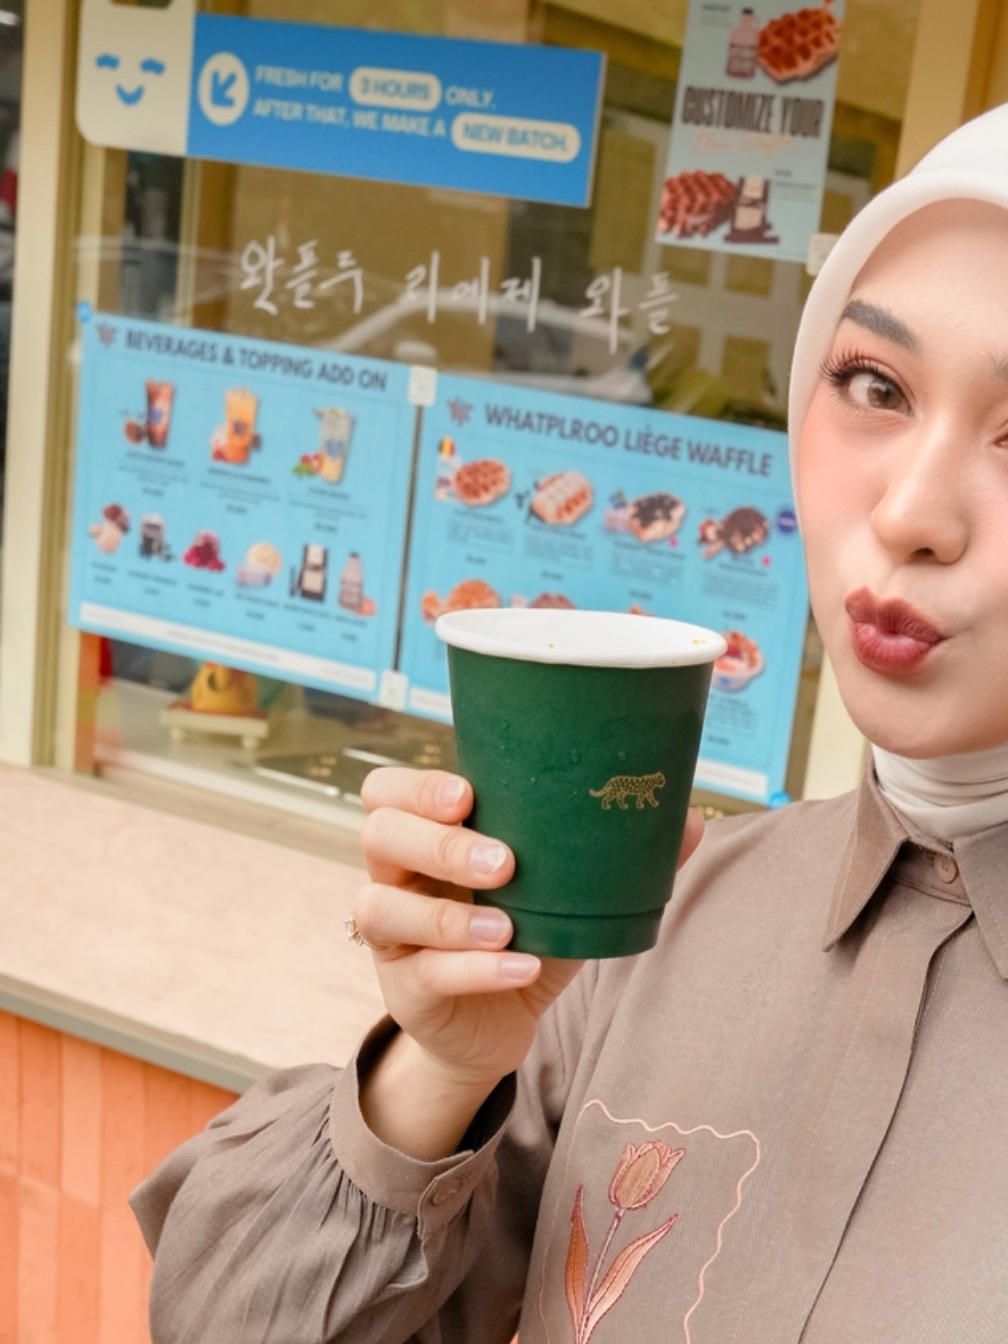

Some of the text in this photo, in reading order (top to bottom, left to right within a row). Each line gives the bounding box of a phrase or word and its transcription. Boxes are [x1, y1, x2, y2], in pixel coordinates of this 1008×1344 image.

[255, 65, 497, 109] FRESH FOR 3 HOURS ONLY.
[682, 86, 825, 138] CUSTOMIZE YOUR
[253, 98, 570, 153] AFTER THAT, WE MAKE A NEW BATCH.
[126, 330, 388, 393] BEVERAGES & TOPPING ADD ON
[485, 402, 773, 478] WHATPLROO LIÈGE WAFFLE
